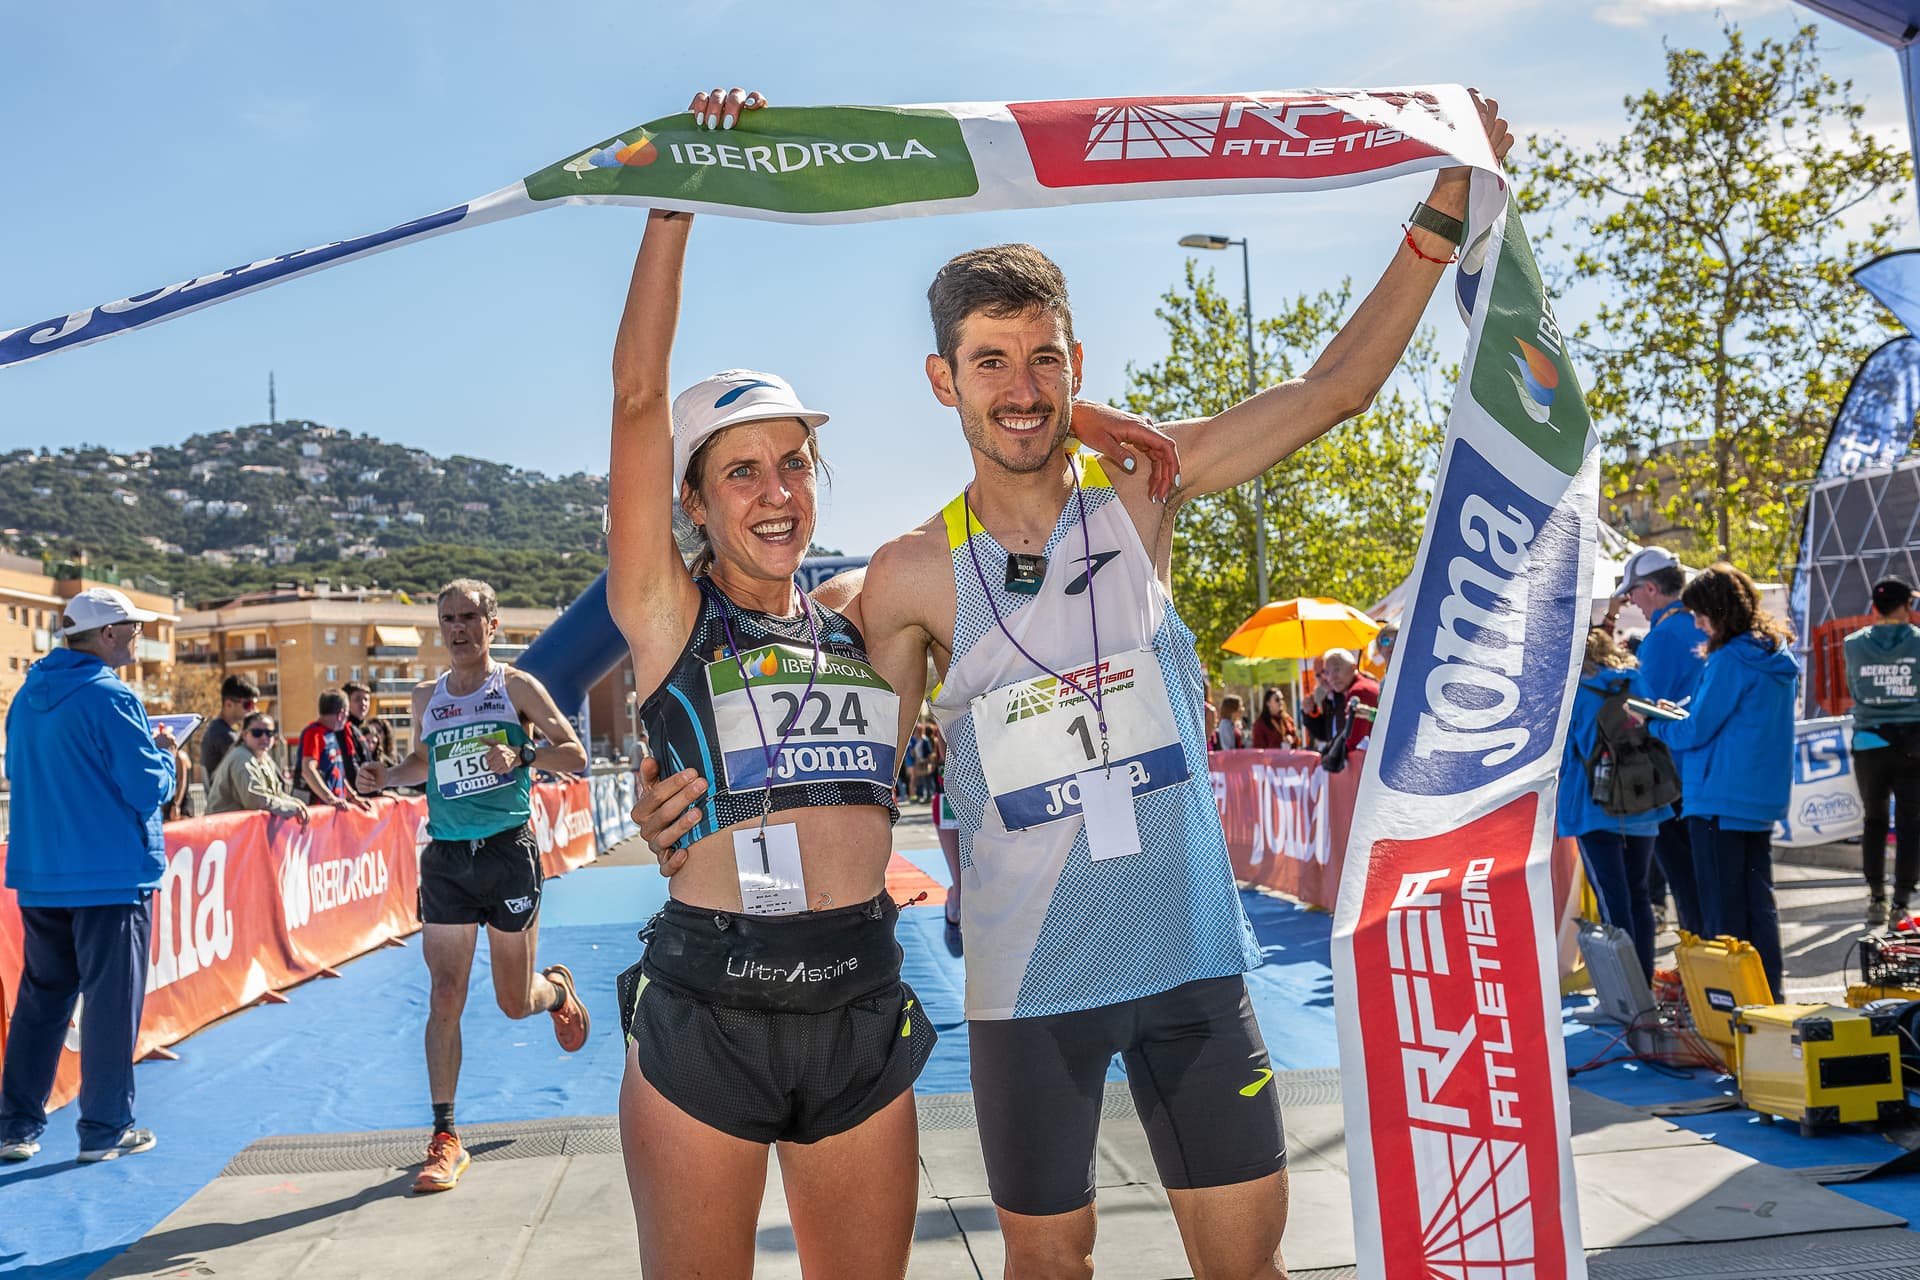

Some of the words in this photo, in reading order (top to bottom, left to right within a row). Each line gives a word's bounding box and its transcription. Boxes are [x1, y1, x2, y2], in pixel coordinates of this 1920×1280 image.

[669, 137, 937, 175] IBERDROLA
[1222, 127, 1412, 157] ATLETIS
[1414, 493, 1535, 767] Joma
[1059, 668, 1134, 698] ATLETISMO
[771, 690, 869, 737] 224
[1066, 715, 1097, 761] 1
[777, 744, 877, 779] Joma
[1045, 760, 1150, 816] Joa
[752, 831, 770, 874] 1
[1387, 867, 1477, 1129] RFEA
[1461, 857, 1523, 1129] ATLETISMO
